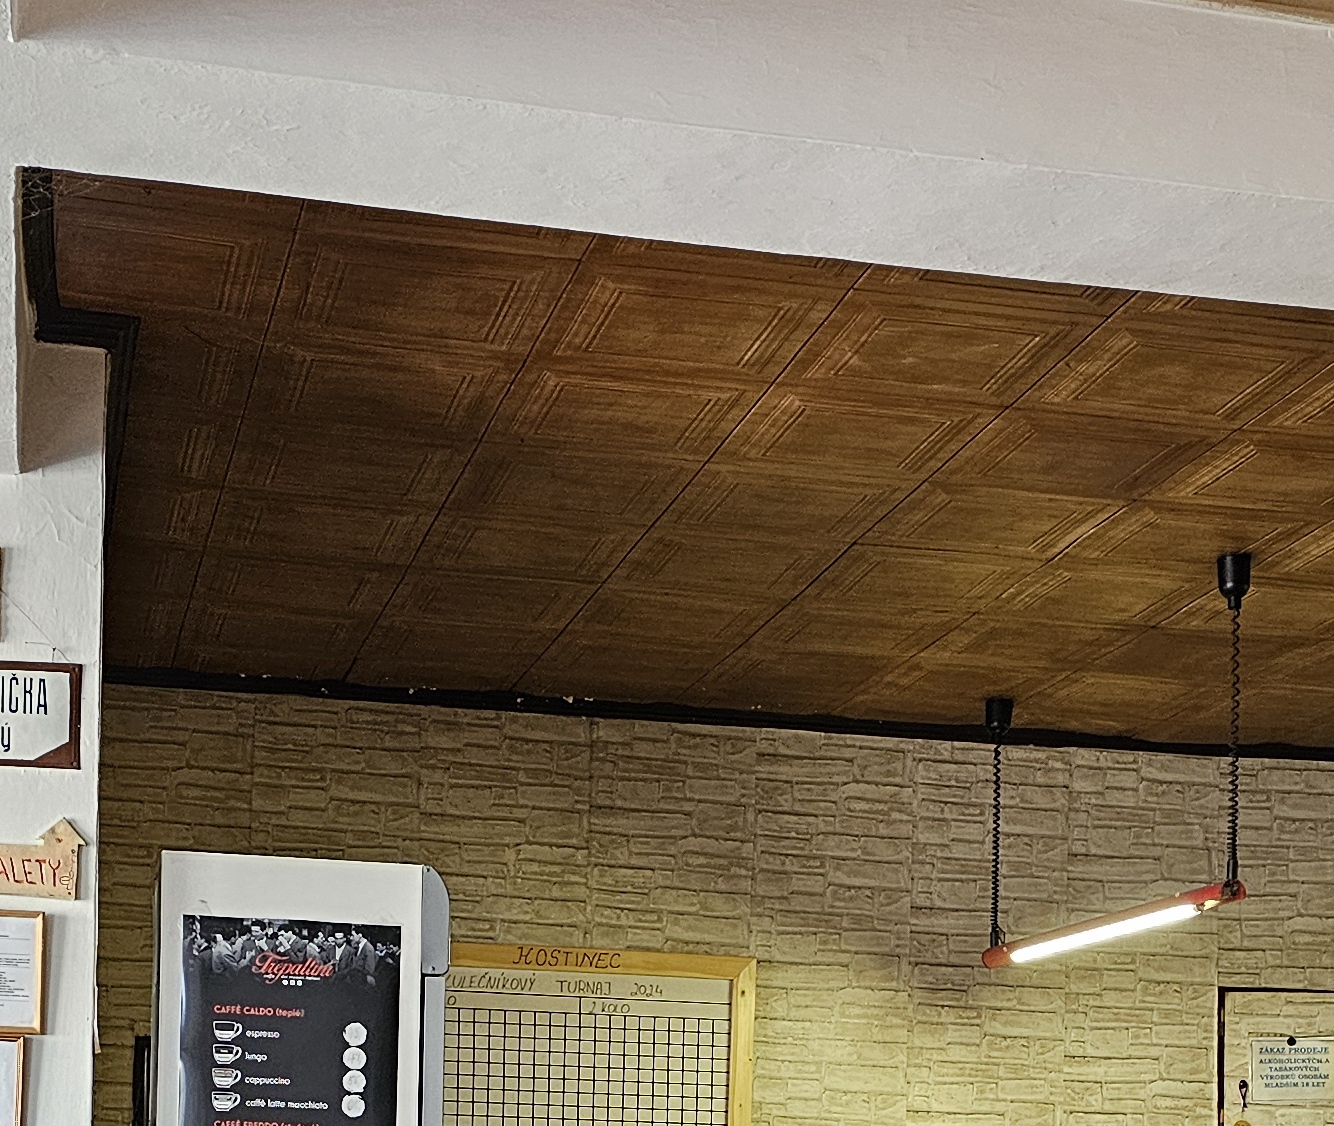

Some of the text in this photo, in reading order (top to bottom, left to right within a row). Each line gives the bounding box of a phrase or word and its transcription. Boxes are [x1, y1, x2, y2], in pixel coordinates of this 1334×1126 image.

[513, 946, 621, 969] HOSTINEC
[556, 979, 612, 996] TURNAJ
[630, 982, 663, 998] 2024
[214, 1004, 241, 1014] CAFFÈ
[243, 1006, 273, 1016] CALDO
[601, 1001, 631, 1014] KOLO
[245, 1030, 280, 1039] espresso
[1259, 1046, 1285, 1054] ZÁKAZ
[244, 1051, 267, 1062] lungo
[1259, 1057, 1323, 1065] ALKOHOLICKÝCH
[244, 1076, 291, 1085] cappuccino
[287, 1100, 329, 1110] macchiato
